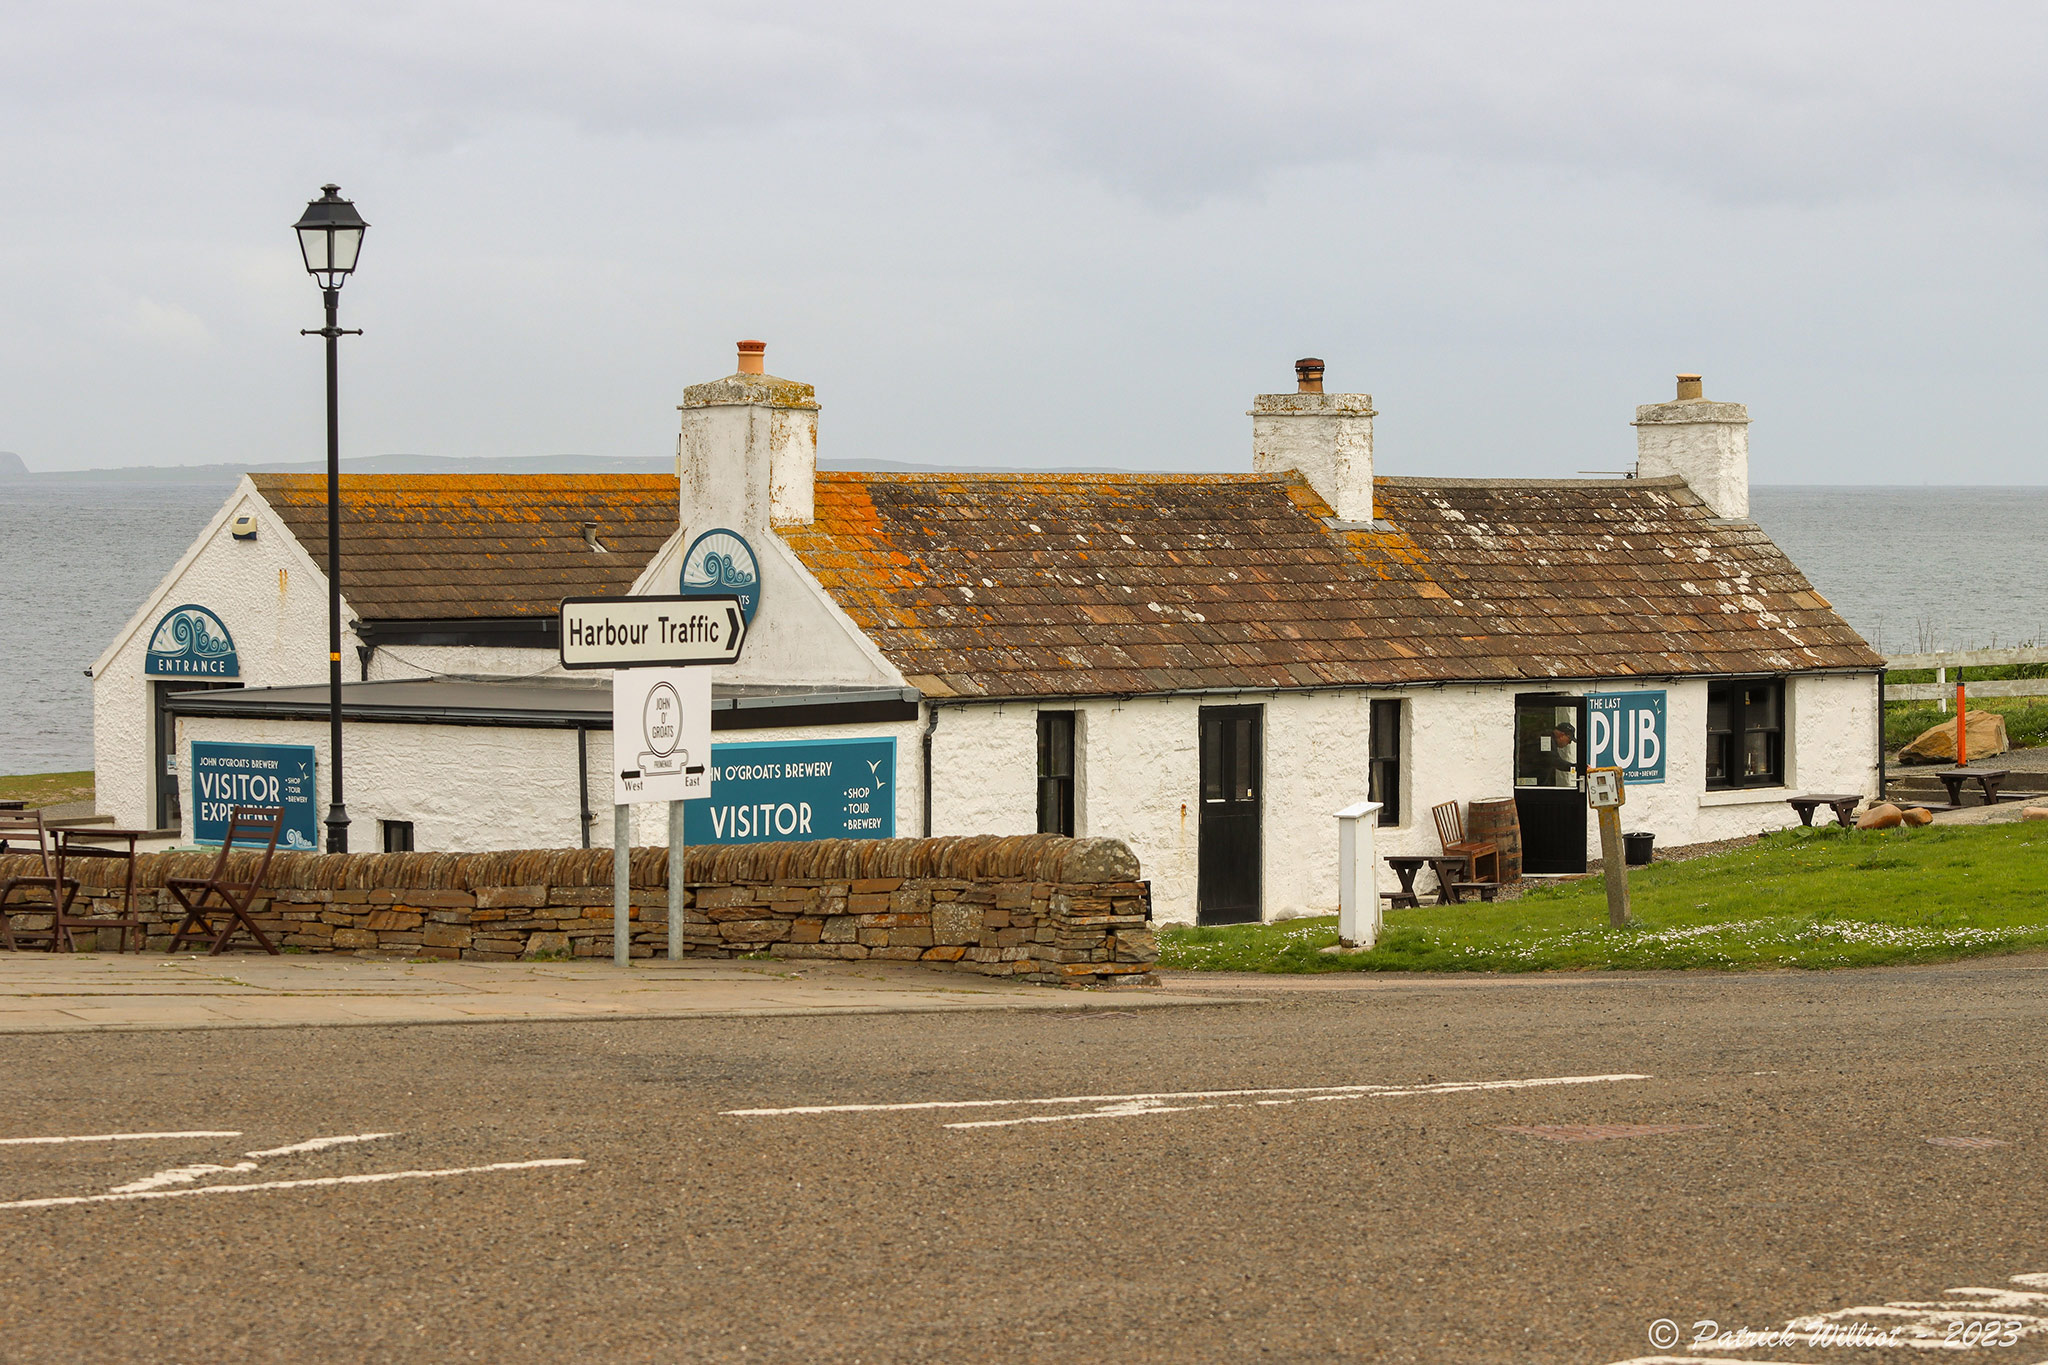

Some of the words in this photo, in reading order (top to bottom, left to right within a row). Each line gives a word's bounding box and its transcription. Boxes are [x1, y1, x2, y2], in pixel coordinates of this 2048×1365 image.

[569, 616, 649, 646] Harbour
[658, 614, 719, 644] Traffic
[158, 659, 225, 673] ENTRANCE
[656, 698, 671, 711] JOHN
[1590, 699, 1603, 710] THE
[1604, 698, 1621, 709] LAST
[652, 725, 674, 739] GROATS
[1590, 709, 1661, 769] PUB
[200, 757, 217, 766] JOHN
[219, 757, 249, 768] O'GROATS
[251, 760, 278, 770] BREWERY
[725, 764, 781, 781] O'GROATS
[785, 761, 833, 779] BREWERY
[199, 772, 280, 802] VISITOR
[287, 777, 301, 785] SHOP
[624, 780, 644, 792] West
[685, 776, 700, 787] East
[288, 786, 301, 794] TOUR
[848, 787, 870, 799] SHOP
[1590, 786, 1597, 795] S
[1608, 783, 1615, 793] V
[848, 803, 870, 814] TOUR
[709, 802, 812, 839] VISITOR
[848, 818, 882, 830] BREWERY
